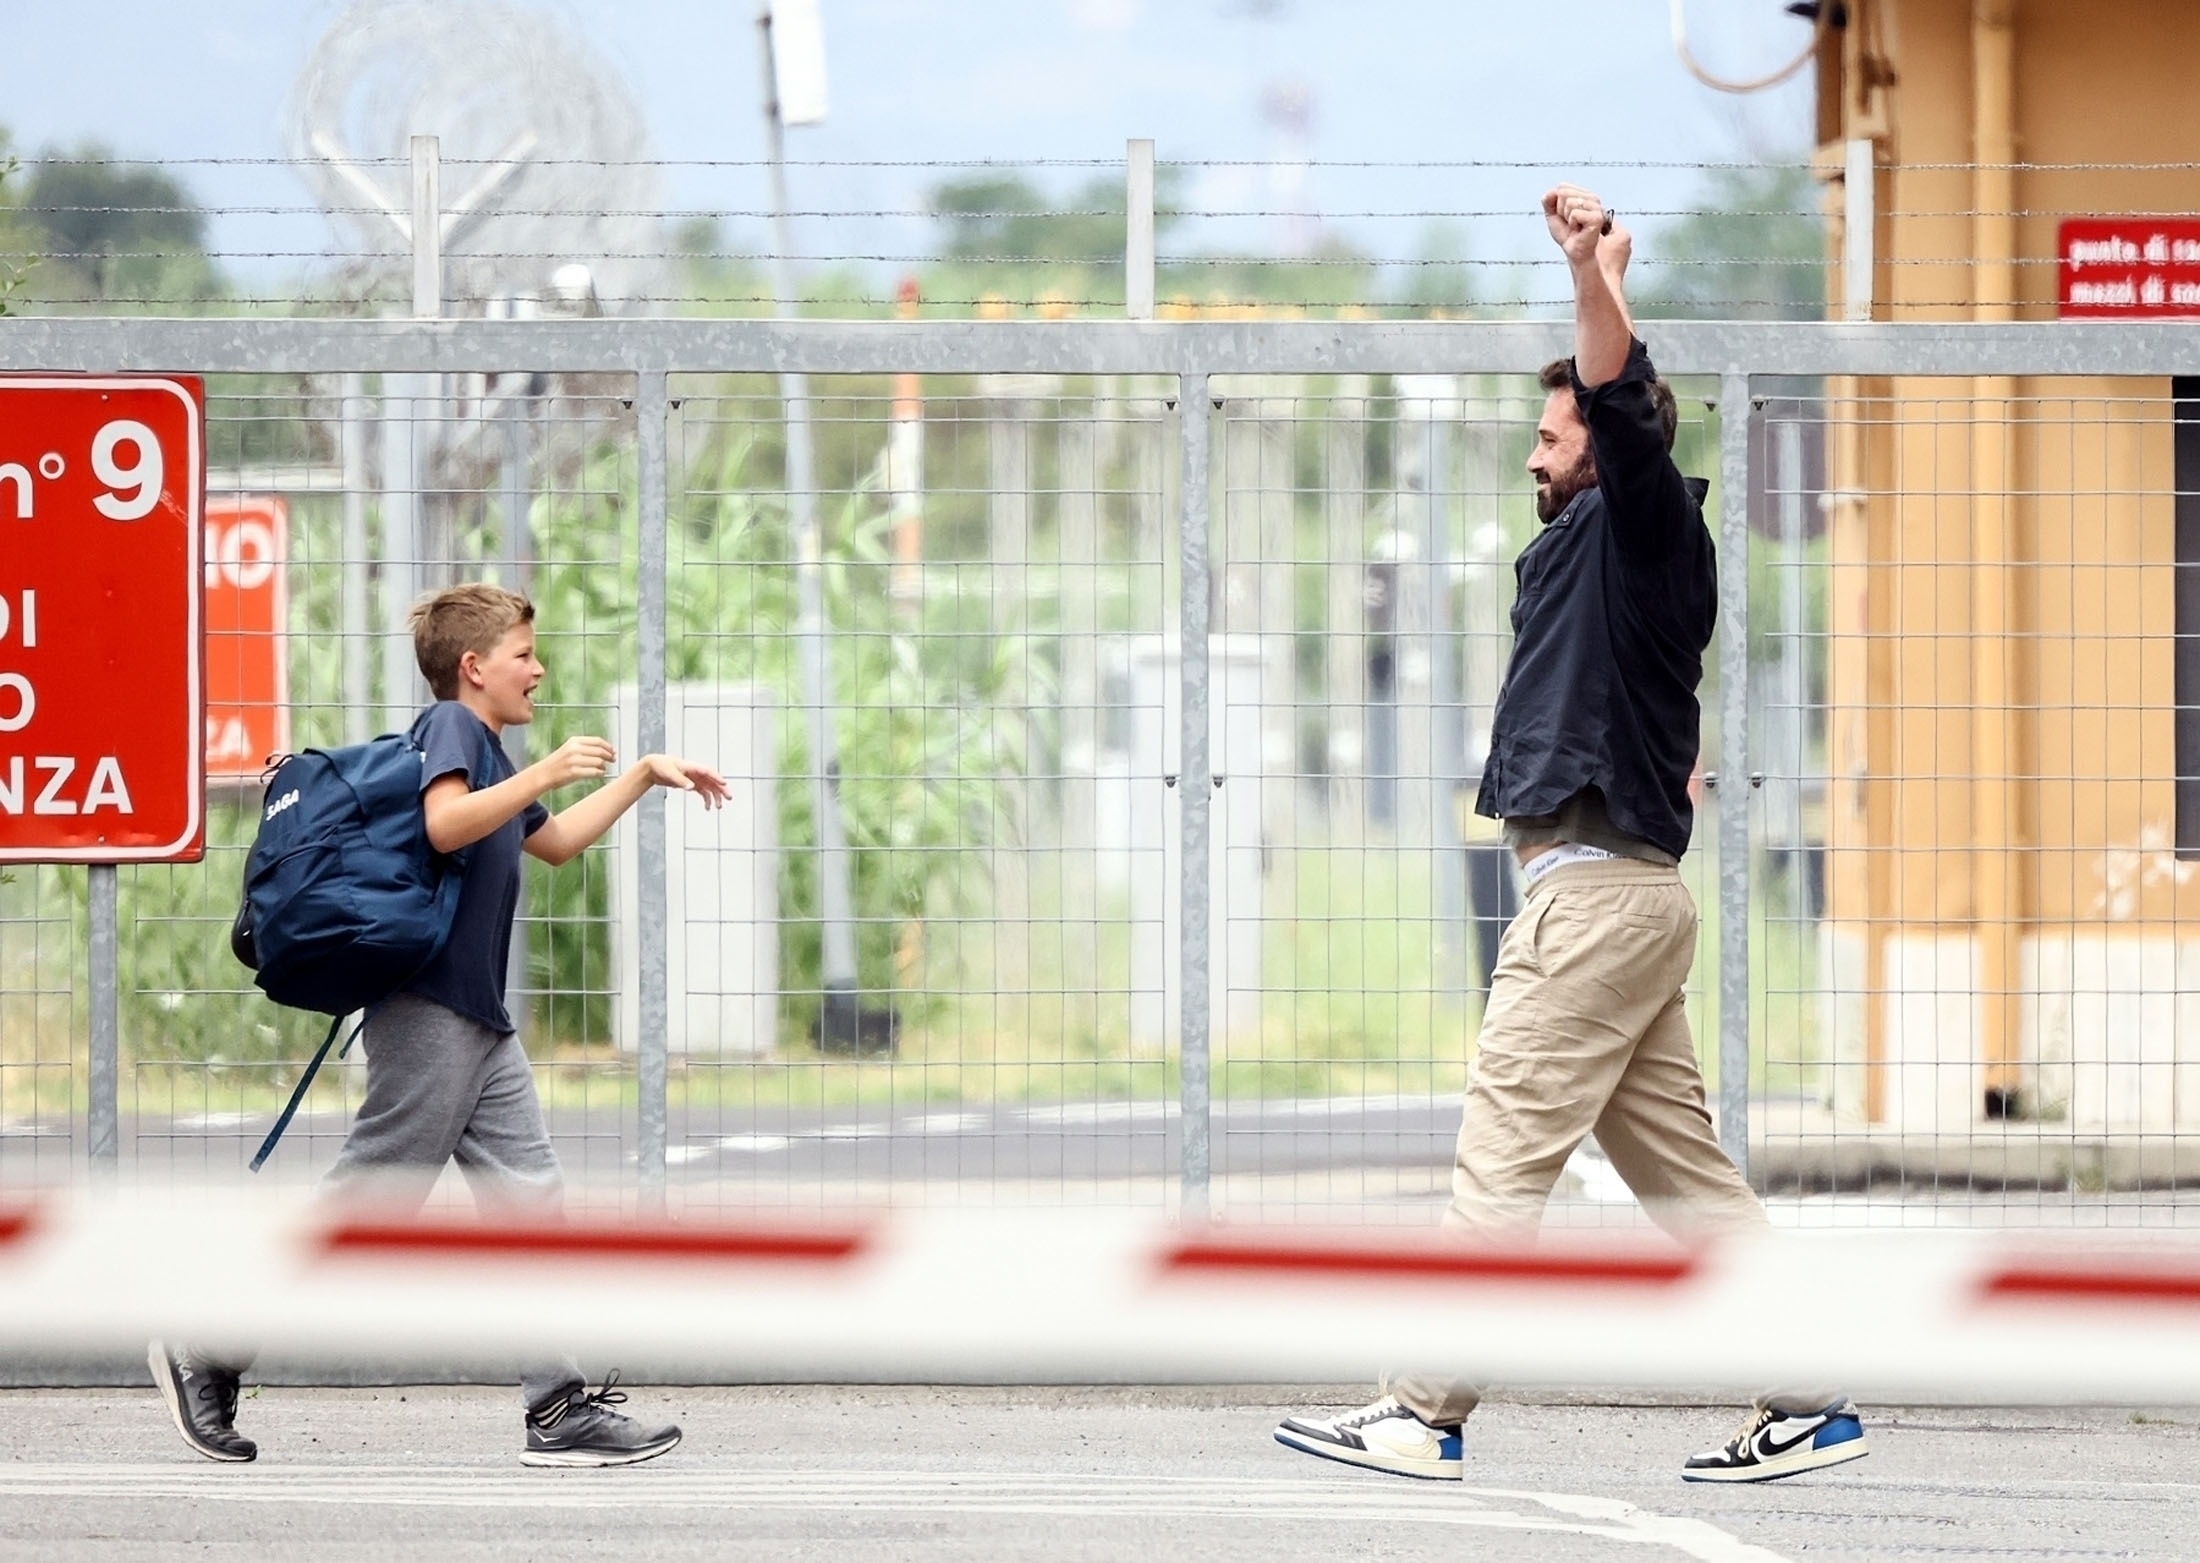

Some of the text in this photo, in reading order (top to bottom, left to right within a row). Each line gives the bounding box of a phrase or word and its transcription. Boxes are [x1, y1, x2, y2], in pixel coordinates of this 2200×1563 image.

[91, 419, 164, 522] 9
[0, 588, 36, 648] I
[266, 788, 299, 821] SAGA
[1574, 848, 1605, 858] Calvin
